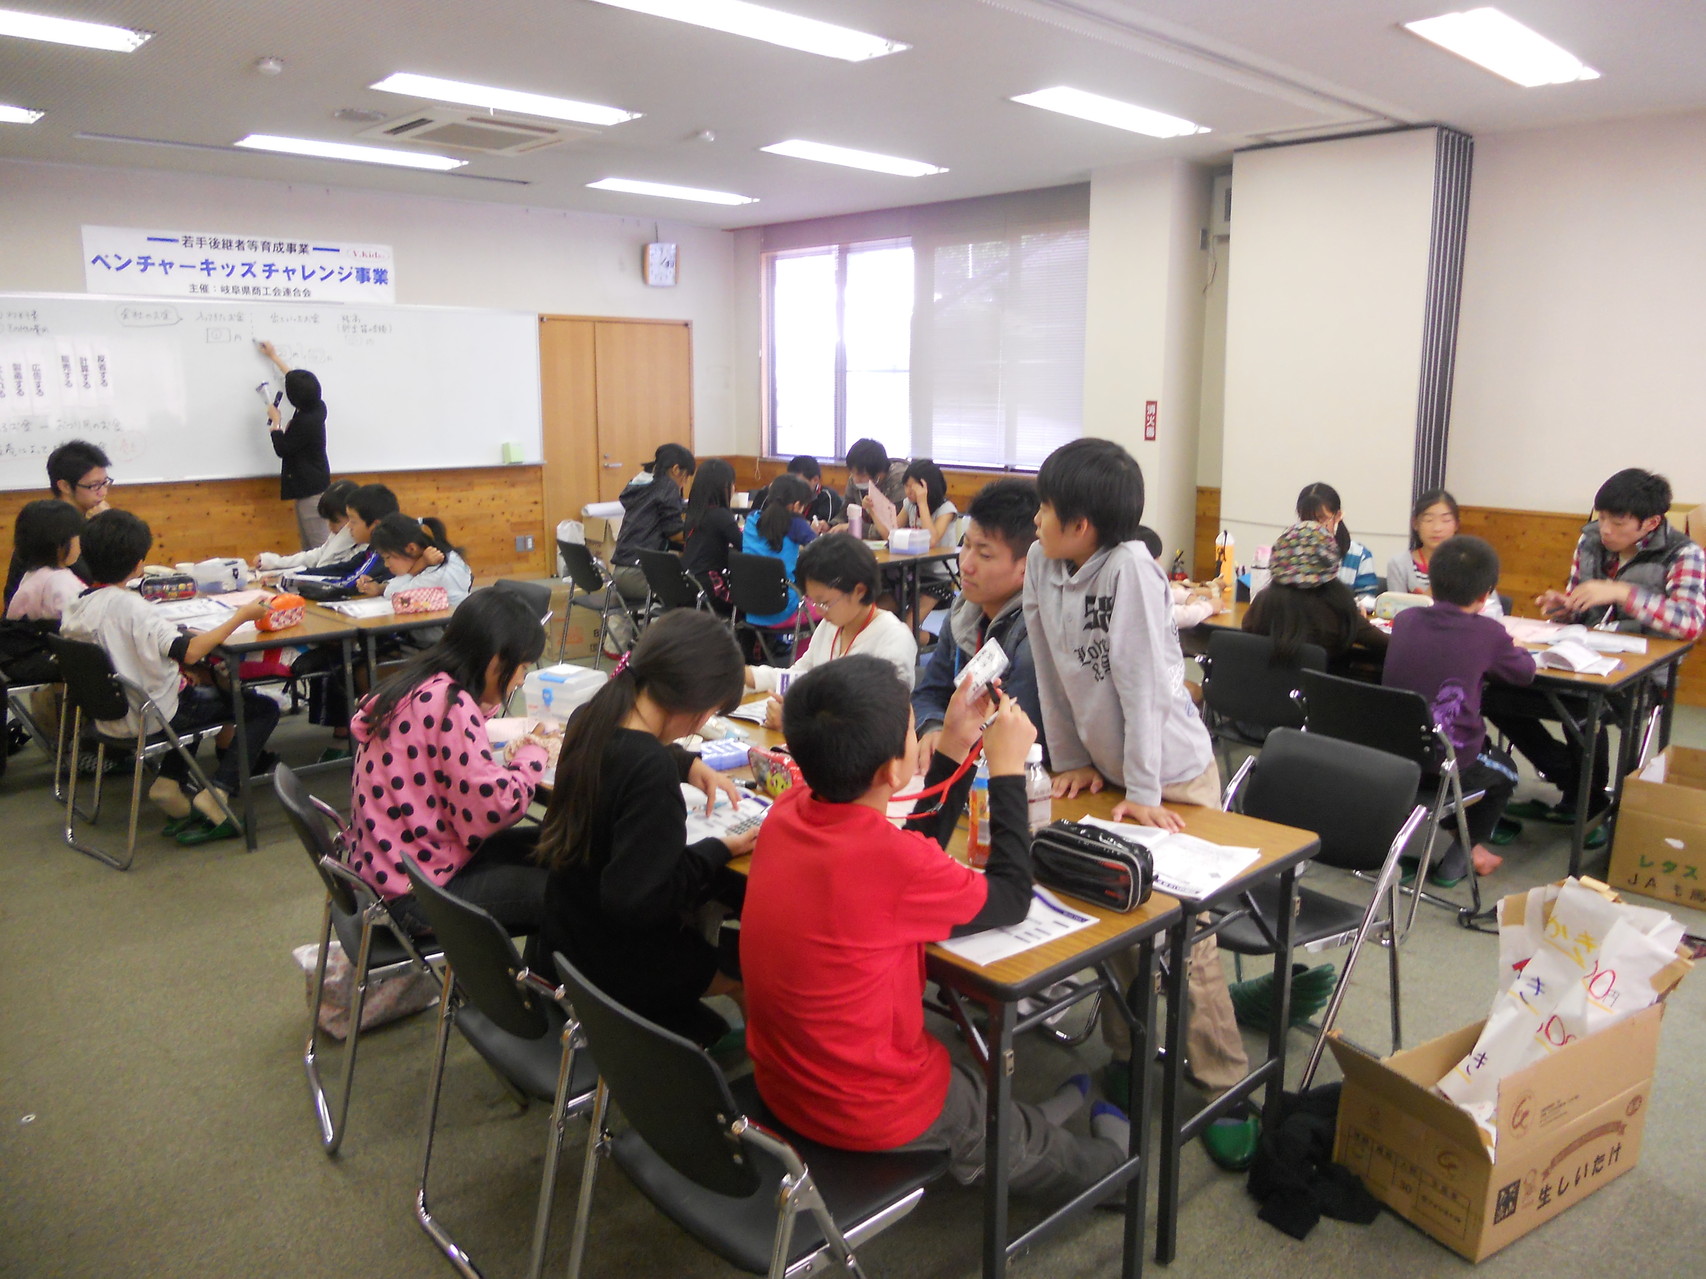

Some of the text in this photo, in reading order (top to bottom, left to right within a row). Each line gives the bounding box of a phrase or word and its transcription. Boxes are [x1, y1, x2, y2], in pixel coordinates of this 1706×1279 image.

[182, 235, 309, 255] 若手後継者等育成事業
[91, 253, 389, 286] ベンチャーキッズチャレンジ事業
[1146, 404, 1156, 438] 消火器
[1639, 854, 1698, 881] レタス
[1536, 1142, 1622, 1211] 生しいたけ
